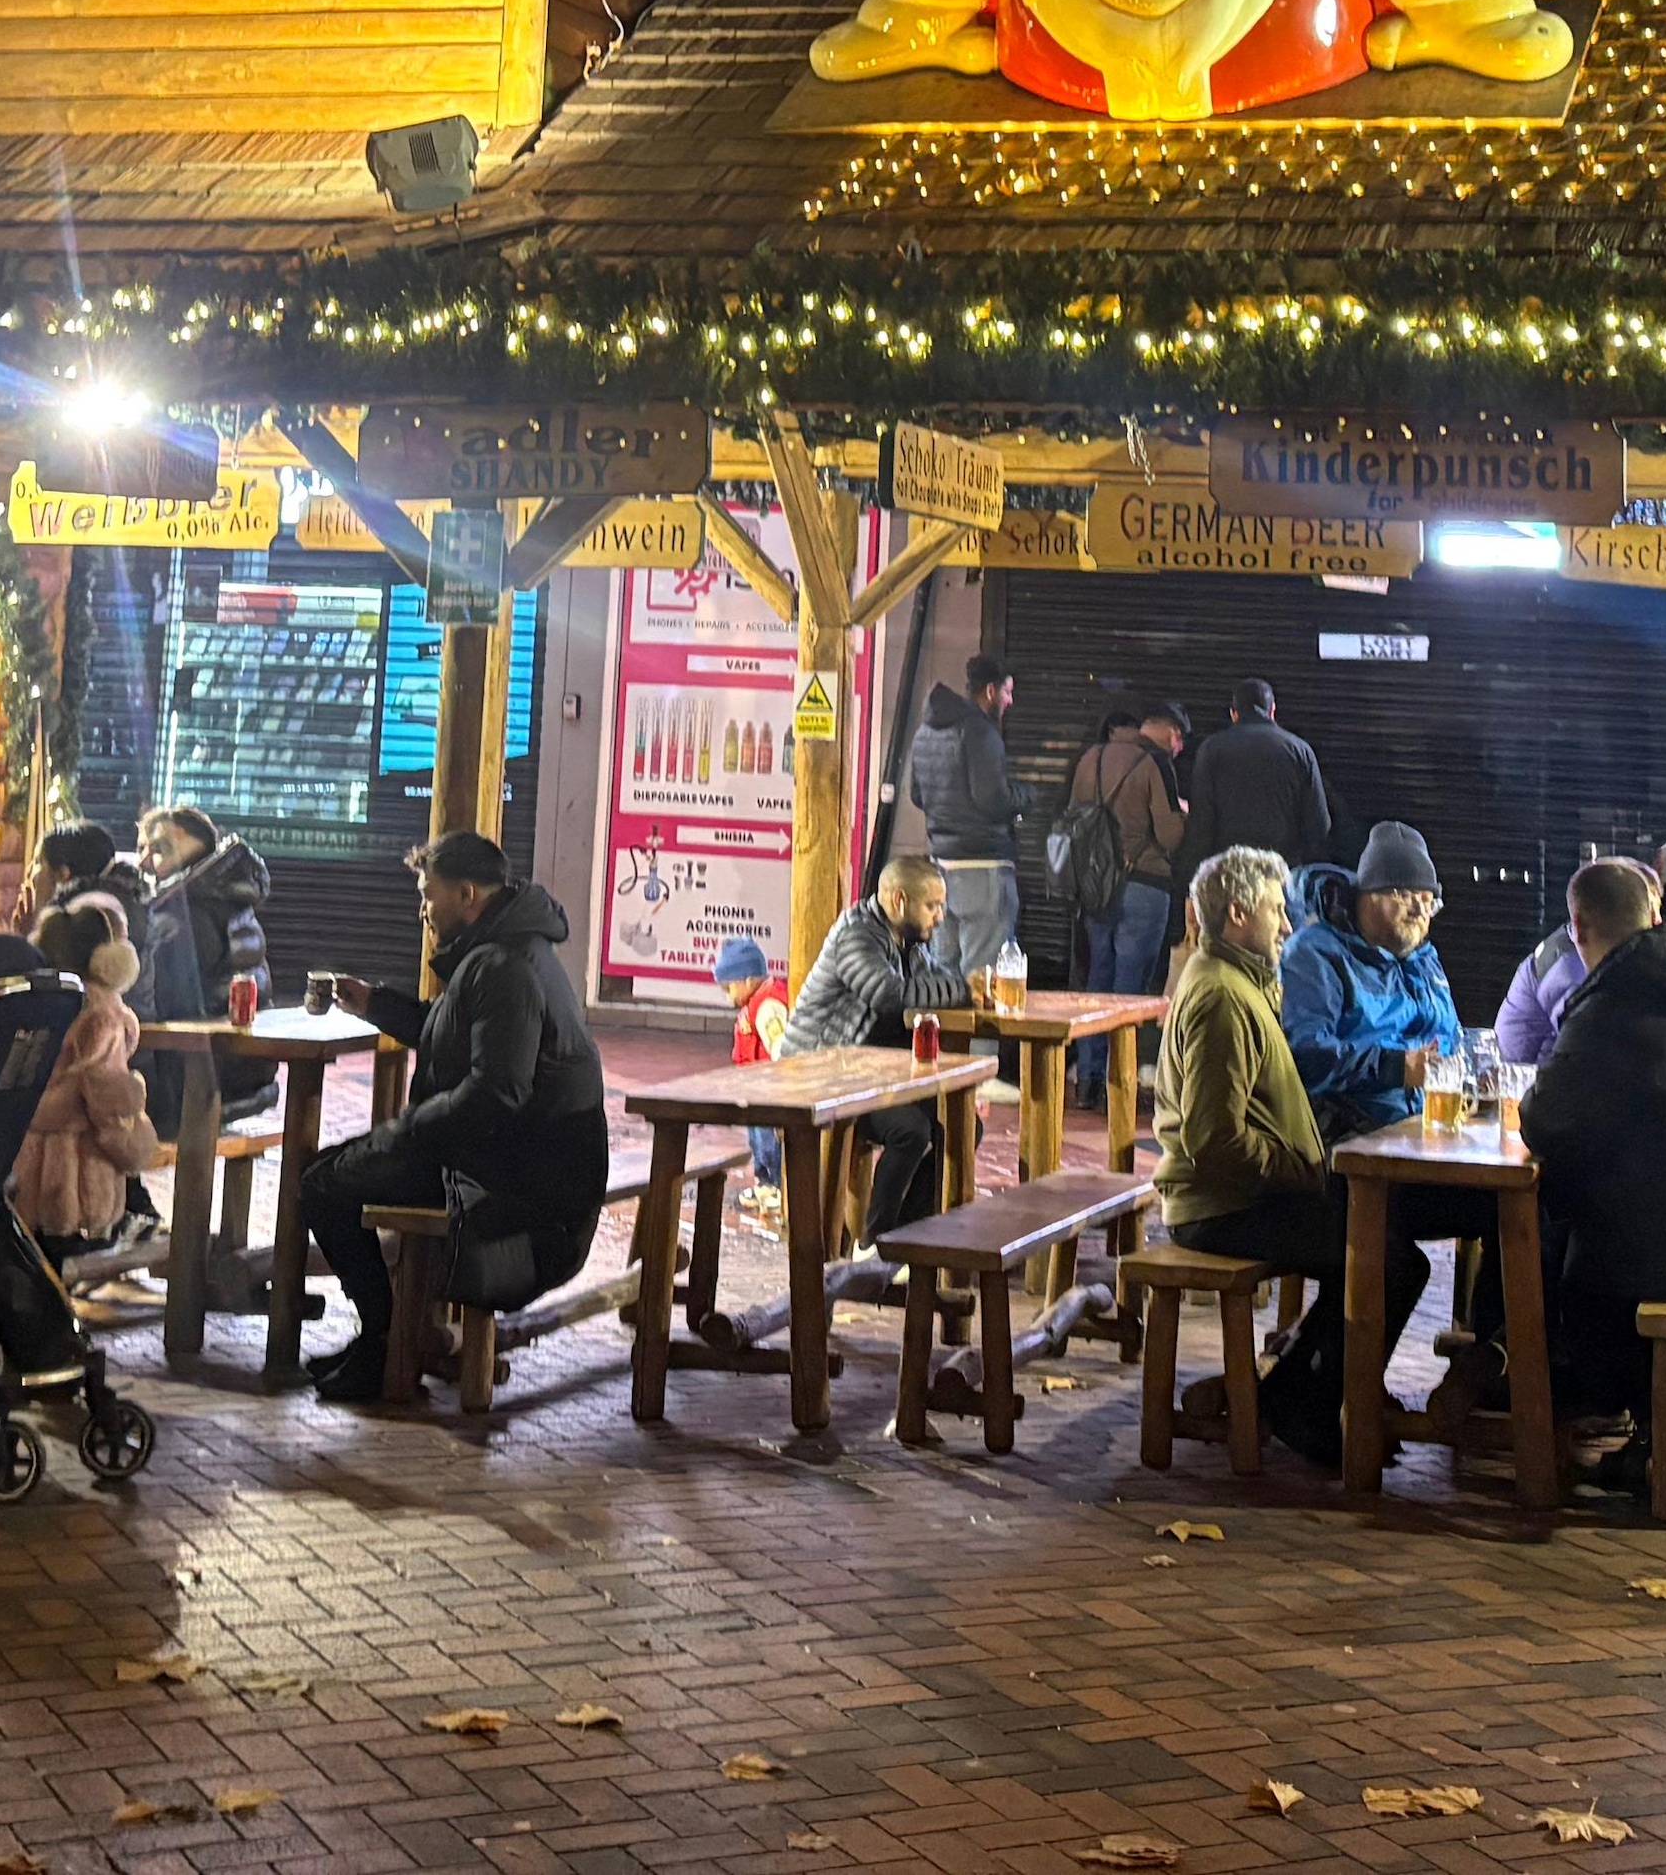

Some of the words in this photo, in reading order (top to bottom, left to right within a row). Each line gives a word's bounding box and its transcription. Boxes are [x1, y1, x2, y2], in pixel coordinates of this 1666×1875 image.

[899, 430, 947, 480] Schoko
[956, 447, 1000, 495] Träume
[1240, 438, 1593, 500] Kinderpunsch
[450, 456, 610, 491] SHANDY
[1120, 492, 1274, 546] GERMAN
[1137, 545, 1271, 570] alcohol
[1289, 548, 1368, 572] free
[725, 659, 761, 672] VAPES
[633, 789, 697, 805] DISPOSABLE
[699, 792, 735, 807] VAPES
[714, 830, 755, 844] SHISHA
[704, 904, 755, 920] PHONES
[686, 919, 772, 939] ACCESSORIES
[693, 935, 719, 950] BUY
[661, 949, 705, 965] TABLET
